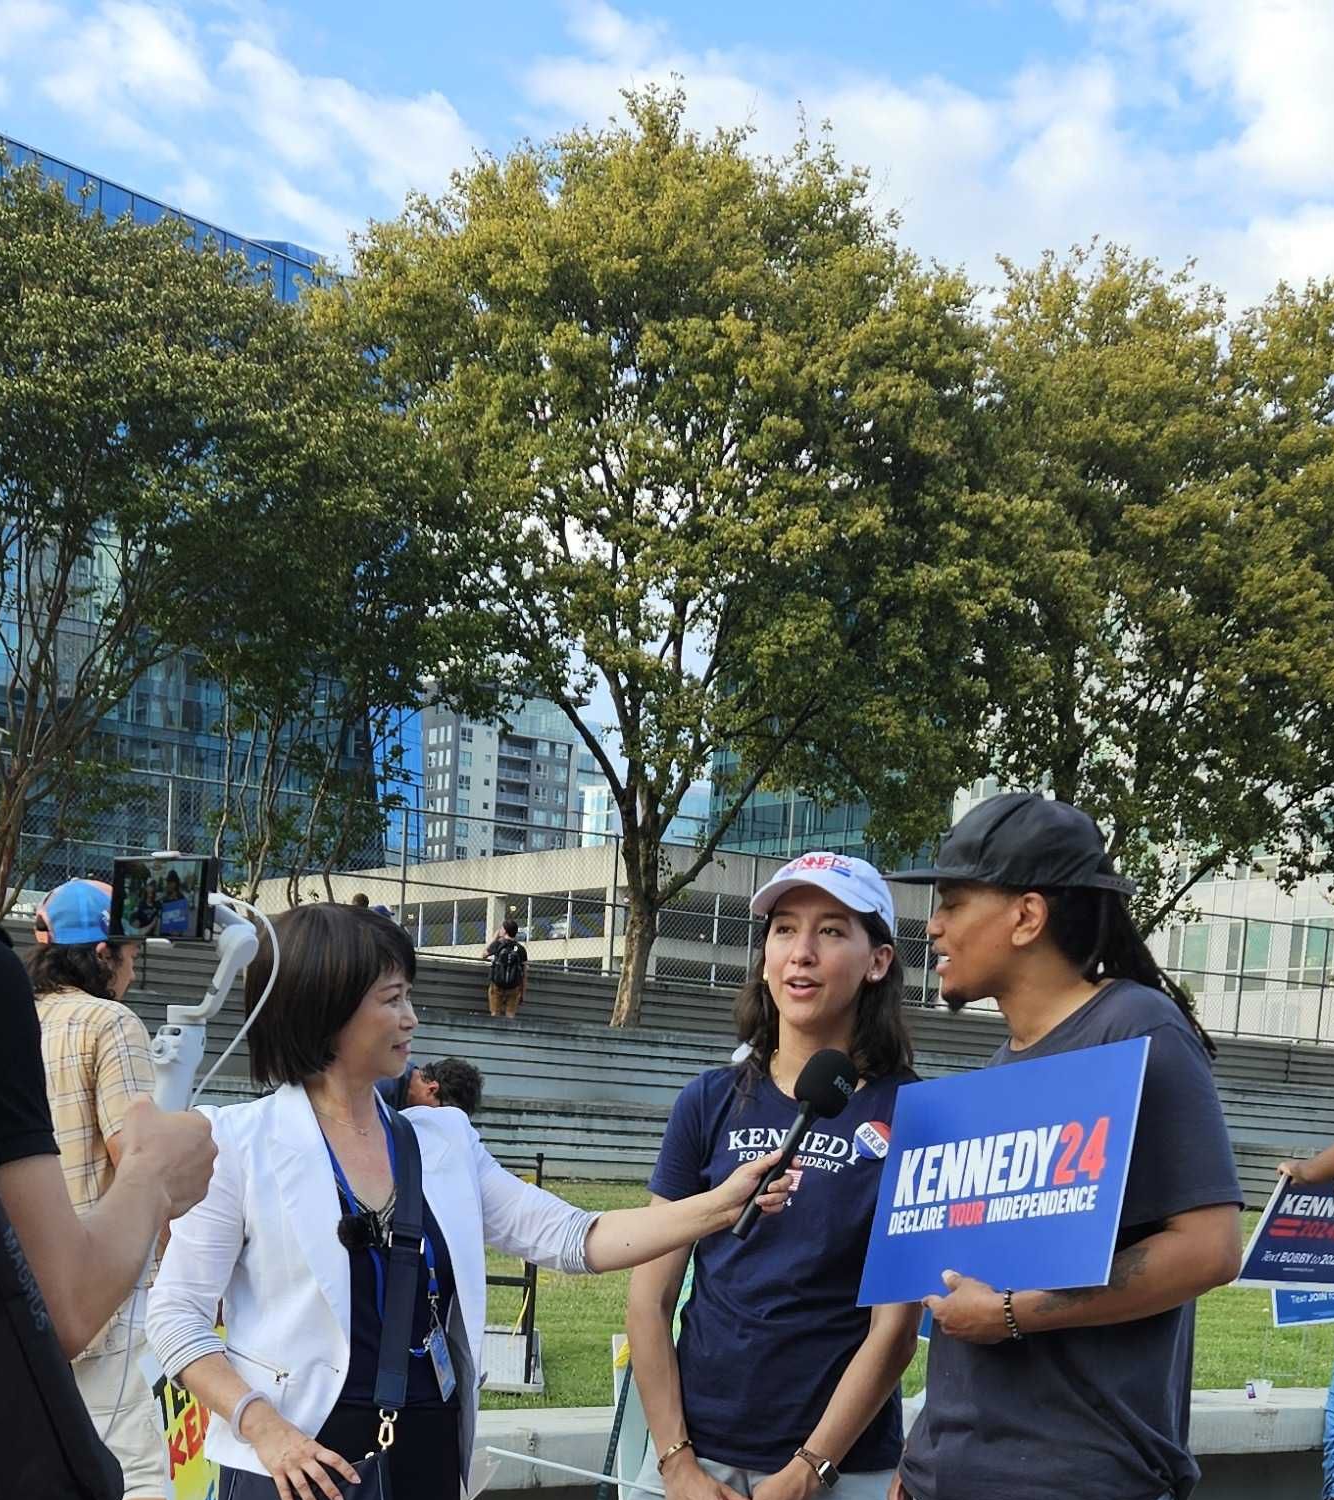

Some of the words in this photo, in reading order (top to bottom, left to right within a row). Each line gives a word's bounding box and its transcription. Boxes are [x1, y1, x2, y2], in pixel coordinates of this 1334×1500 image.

[887, 1205, 947, 1236] DECLARE
[948, 1200, 986, 1228] YOUR
[986, 1185, 1099, 1224] INDEPENDENCE
[1279, 1252, 1311, 1264] BOBBY
